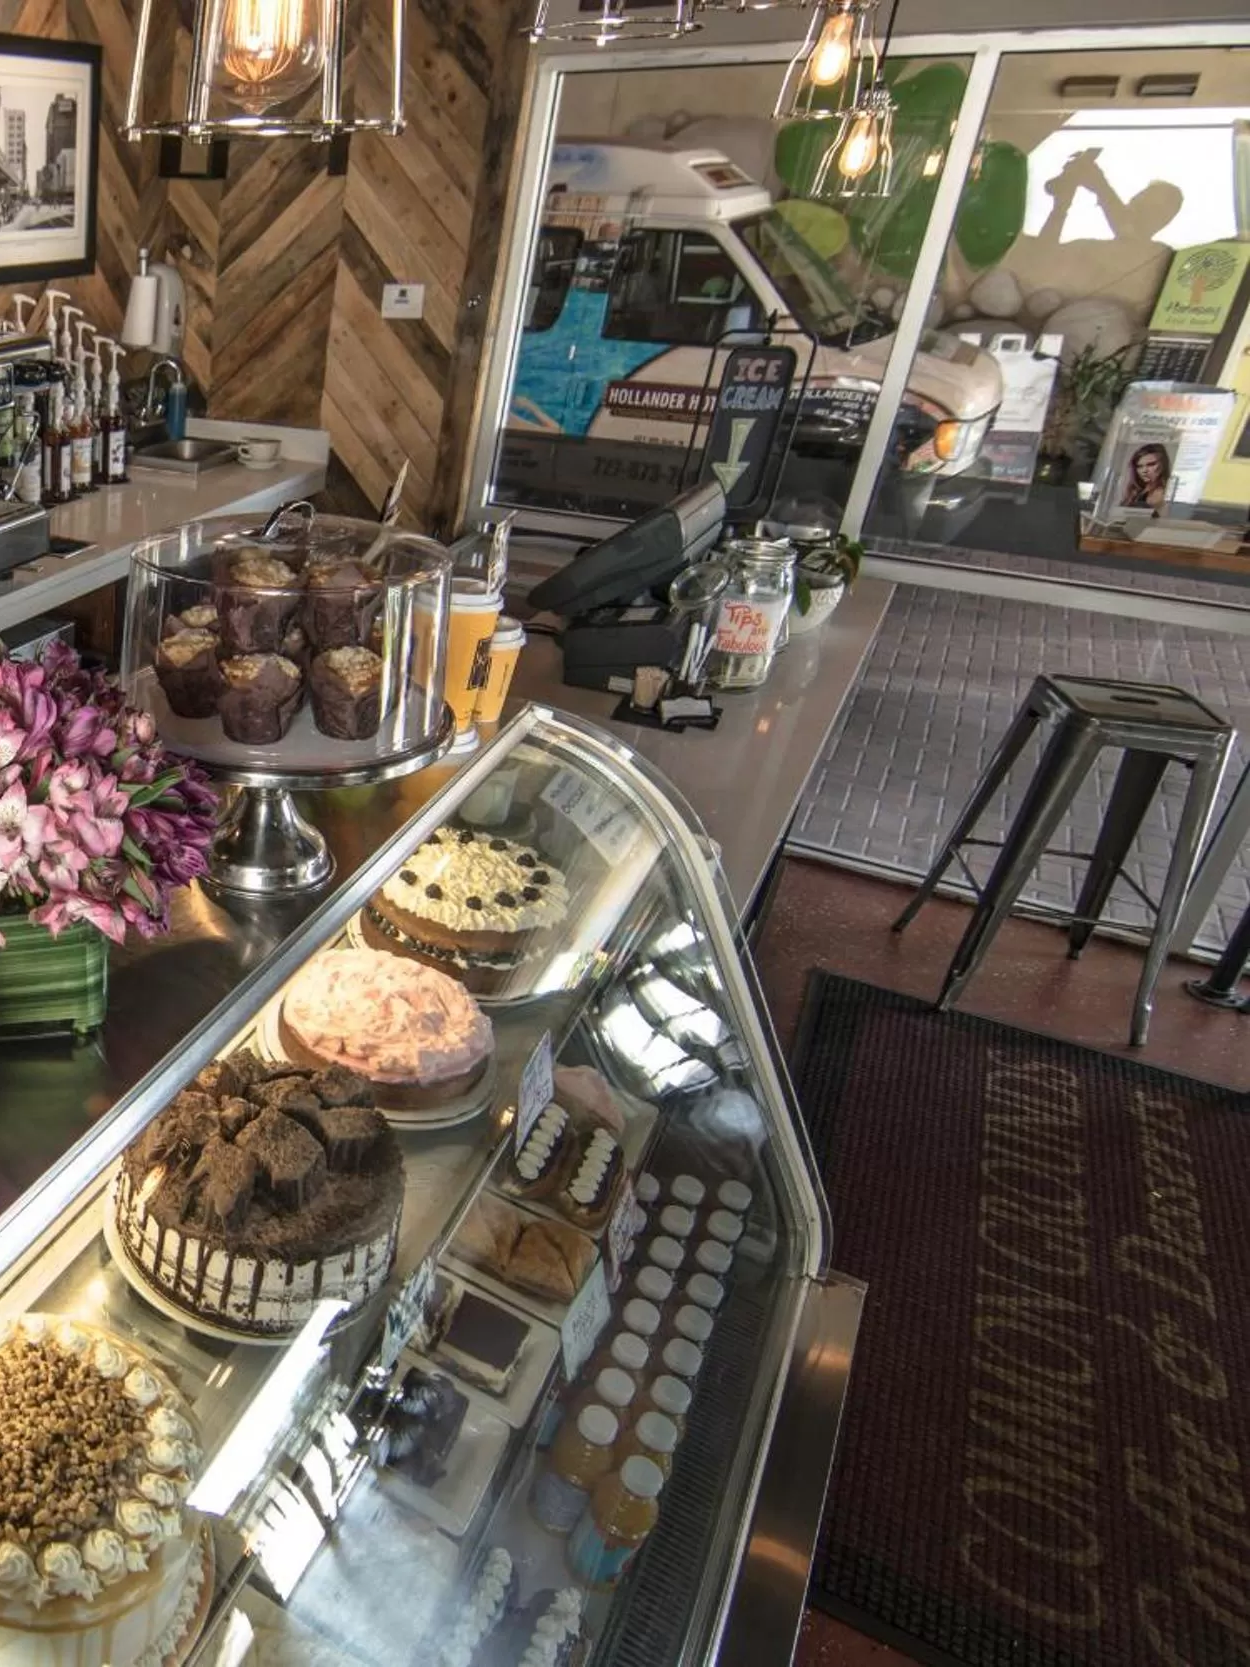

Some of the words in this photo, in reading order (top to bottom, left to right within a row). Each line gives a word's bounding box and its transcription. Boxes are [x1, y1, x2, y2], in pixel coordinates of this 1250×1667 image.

[732, 357, 783, 382] ICE
[609, 388, 687, 410] HOLLANDER
[719, 385, 785, 411] CREAM
[724, 602, 763, 630] Tips
